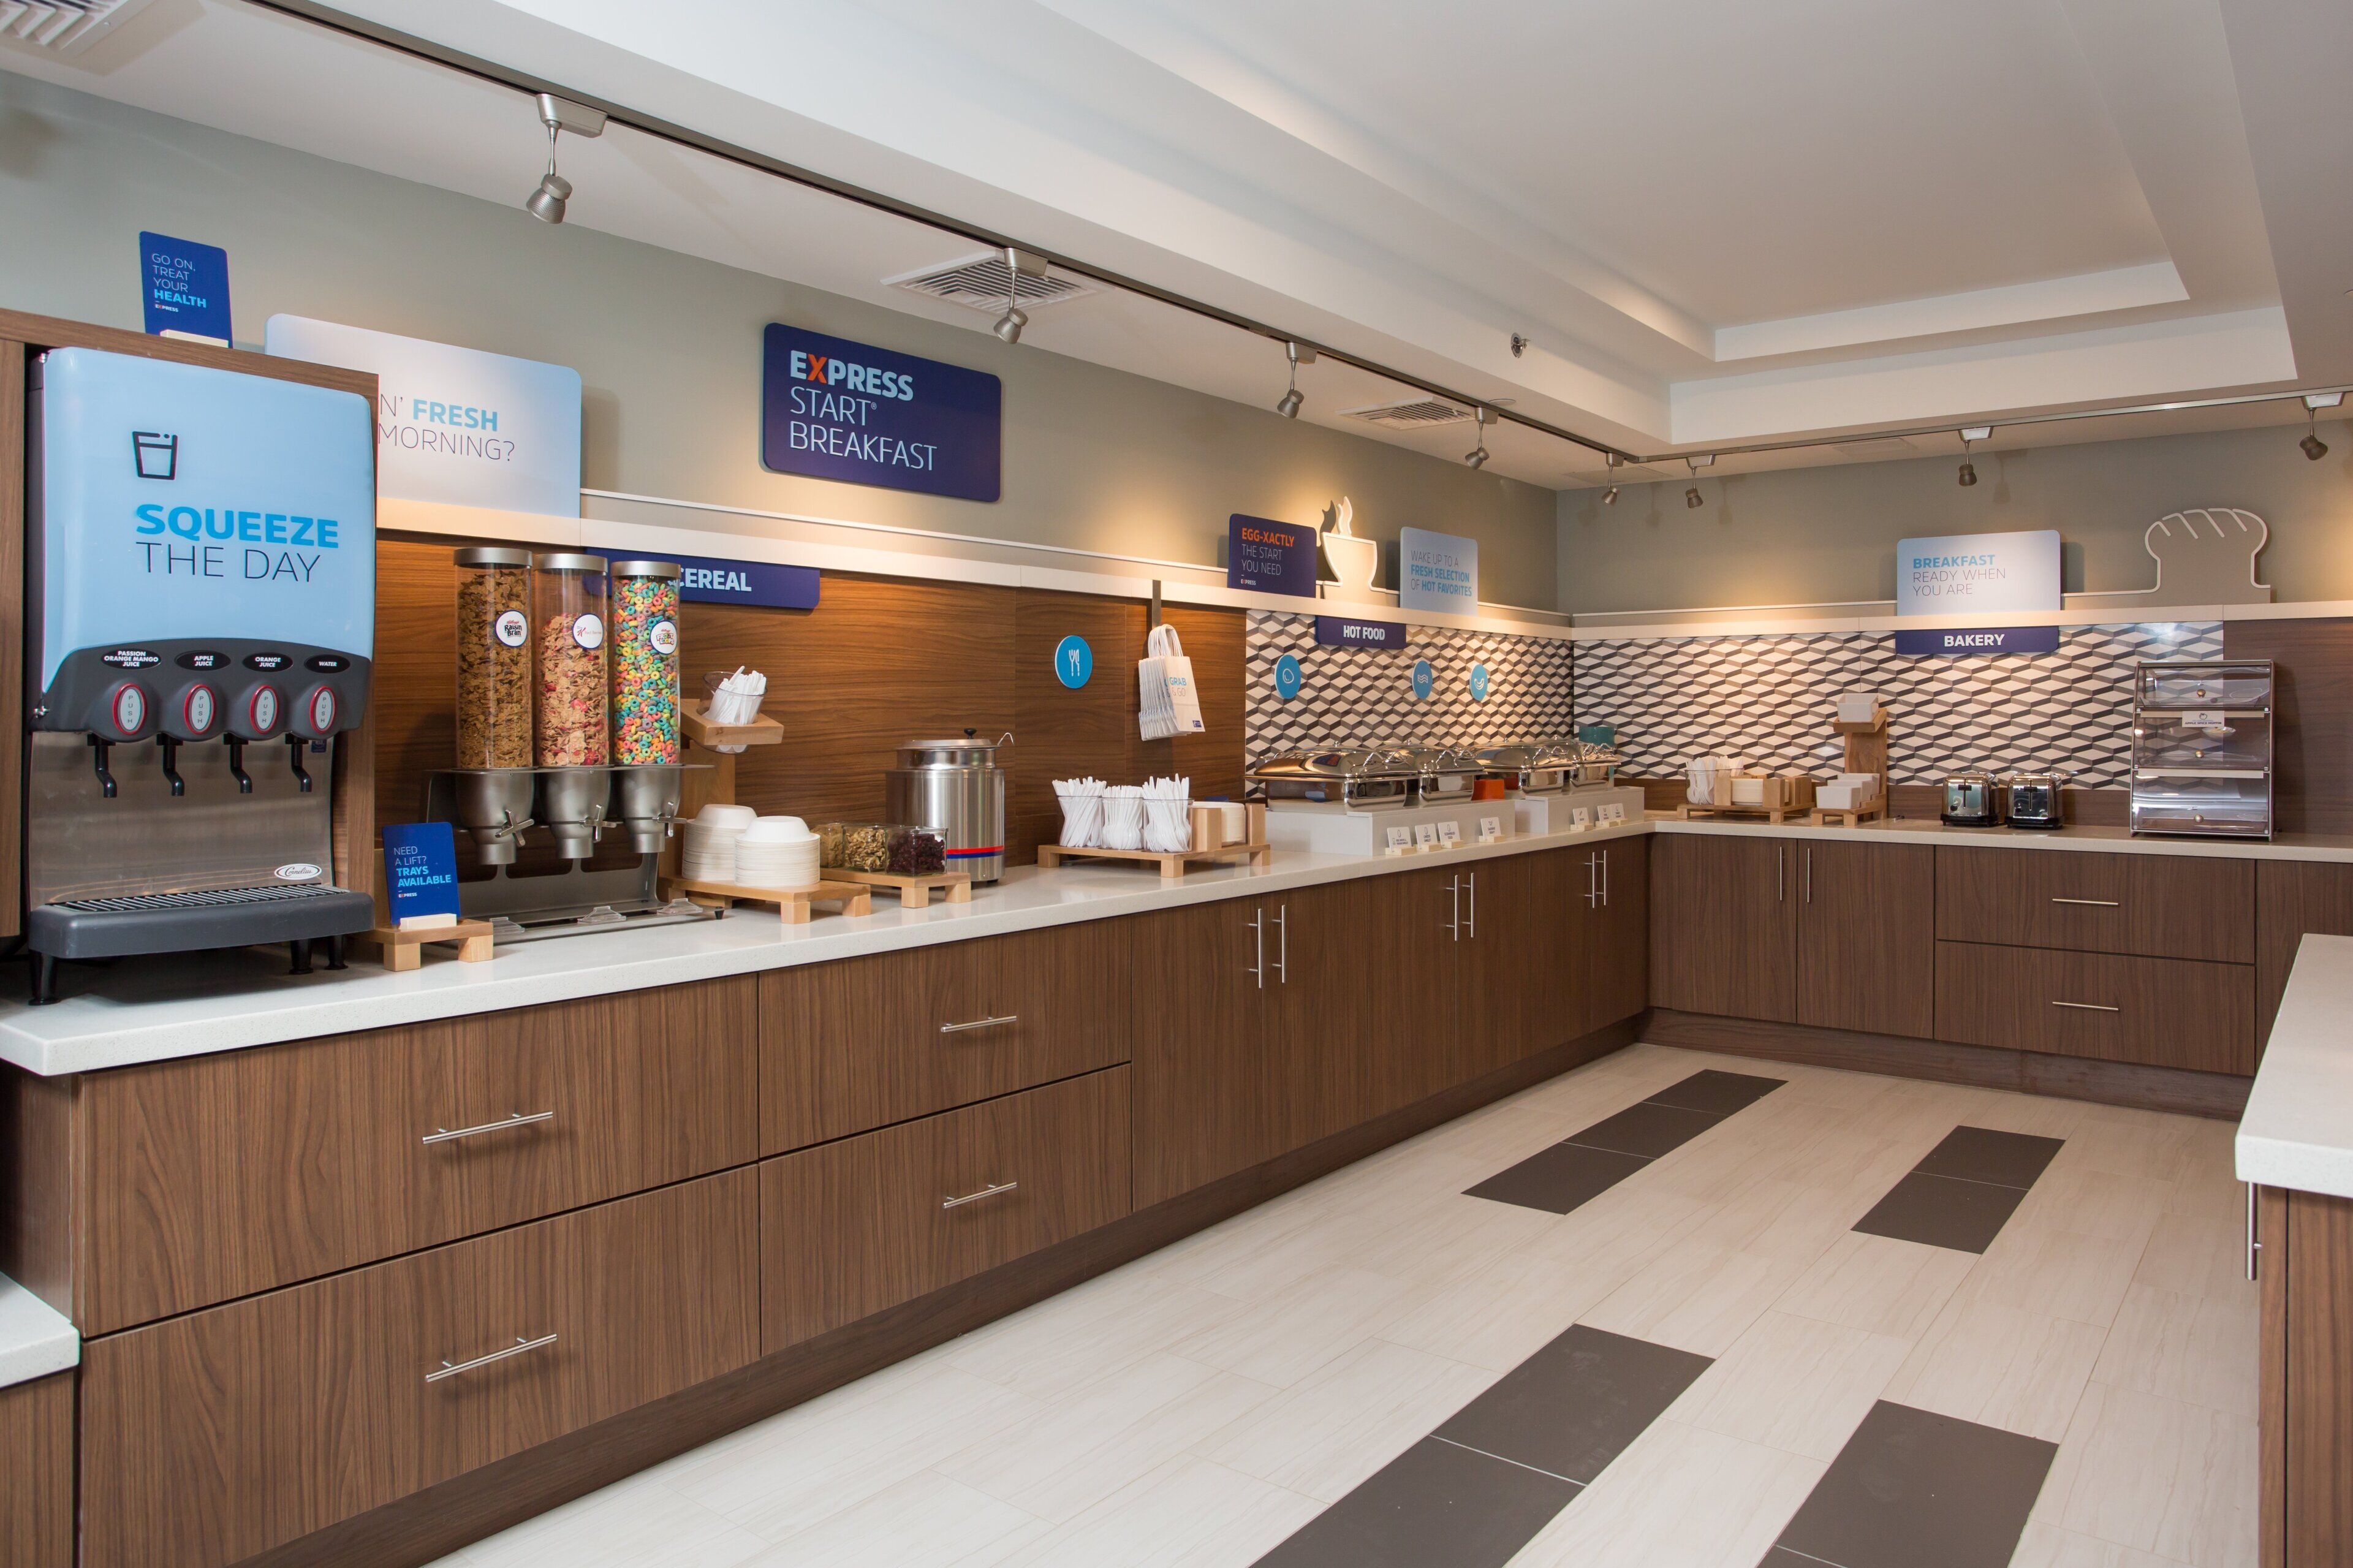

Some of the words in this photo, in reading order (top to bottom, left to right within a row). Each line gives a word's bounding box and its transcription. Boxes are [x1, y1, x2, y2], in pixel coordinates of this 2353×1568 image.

[152, 253, 170, 265] GO
[175, 258, 196, 272] ON,
[153, 265, 190, 281] TREAT
[153, 277, 188, 293] YOUR
[154, 289, 207, 308] HEALTH
[155, 304, 179, 312] EXPRESS
[790, 350, 914, 401] EXPRESS
[412, 399, 498, 431] FRESH
[378, 423, 515, 461] MORNING?
[790, 420, 938, 471] BREAKFAST
[136, 504, 339, 548] SQUEEZE
[1241, 528, 1295, 547] EGG-XACTLY
[1241, 544, 1257, 558] THE
[1259, 547, 1283, 561] START
[1411, 550, 1431, 564] WAKE
[1433, 553, 1442, 565] UP
[1444, 555, 1452, 567] TO
[1454, 557, 1459, 567] A
[136, 542, 224, 577] THE
[244, 549, 320, 582] DAY
[1241, 559, 1259, 572] YOU
[1261, 562, 1281, 575] NEED
[1912, 555, 1996, 569] BREAKFAST
[1411, 564, 1433, 578] FRESH
[1435, 567, 1470, 583] SELECTION
[1913, 570, 1957, 583] READY
[1963, 568, 2006, 580] WHEN
[1411, 578, 1420, 590] OF
[1422, 580, 1436, 592] HOT
[1438, 582, 1472, 597] FAVORITES
[1913, 585, 1941, 596] YOU
[1946, 583, 1973, 595] ARE
[1343, 625, 1361, 638] HOT
[1362, 627, 1385, 640] FOOD
[1944, 634, 2005, 647] BAKERY
[1169, 677, 1187, 686] GRAB
[1177, 687, 1186, 697] GO
[394, 846, 417, 855] NEED
[404, 855, 427, 865] LIFT?
[396, 866, 429, 877] TRAYS
[398, 874, 452, 887] AVAILABLE
